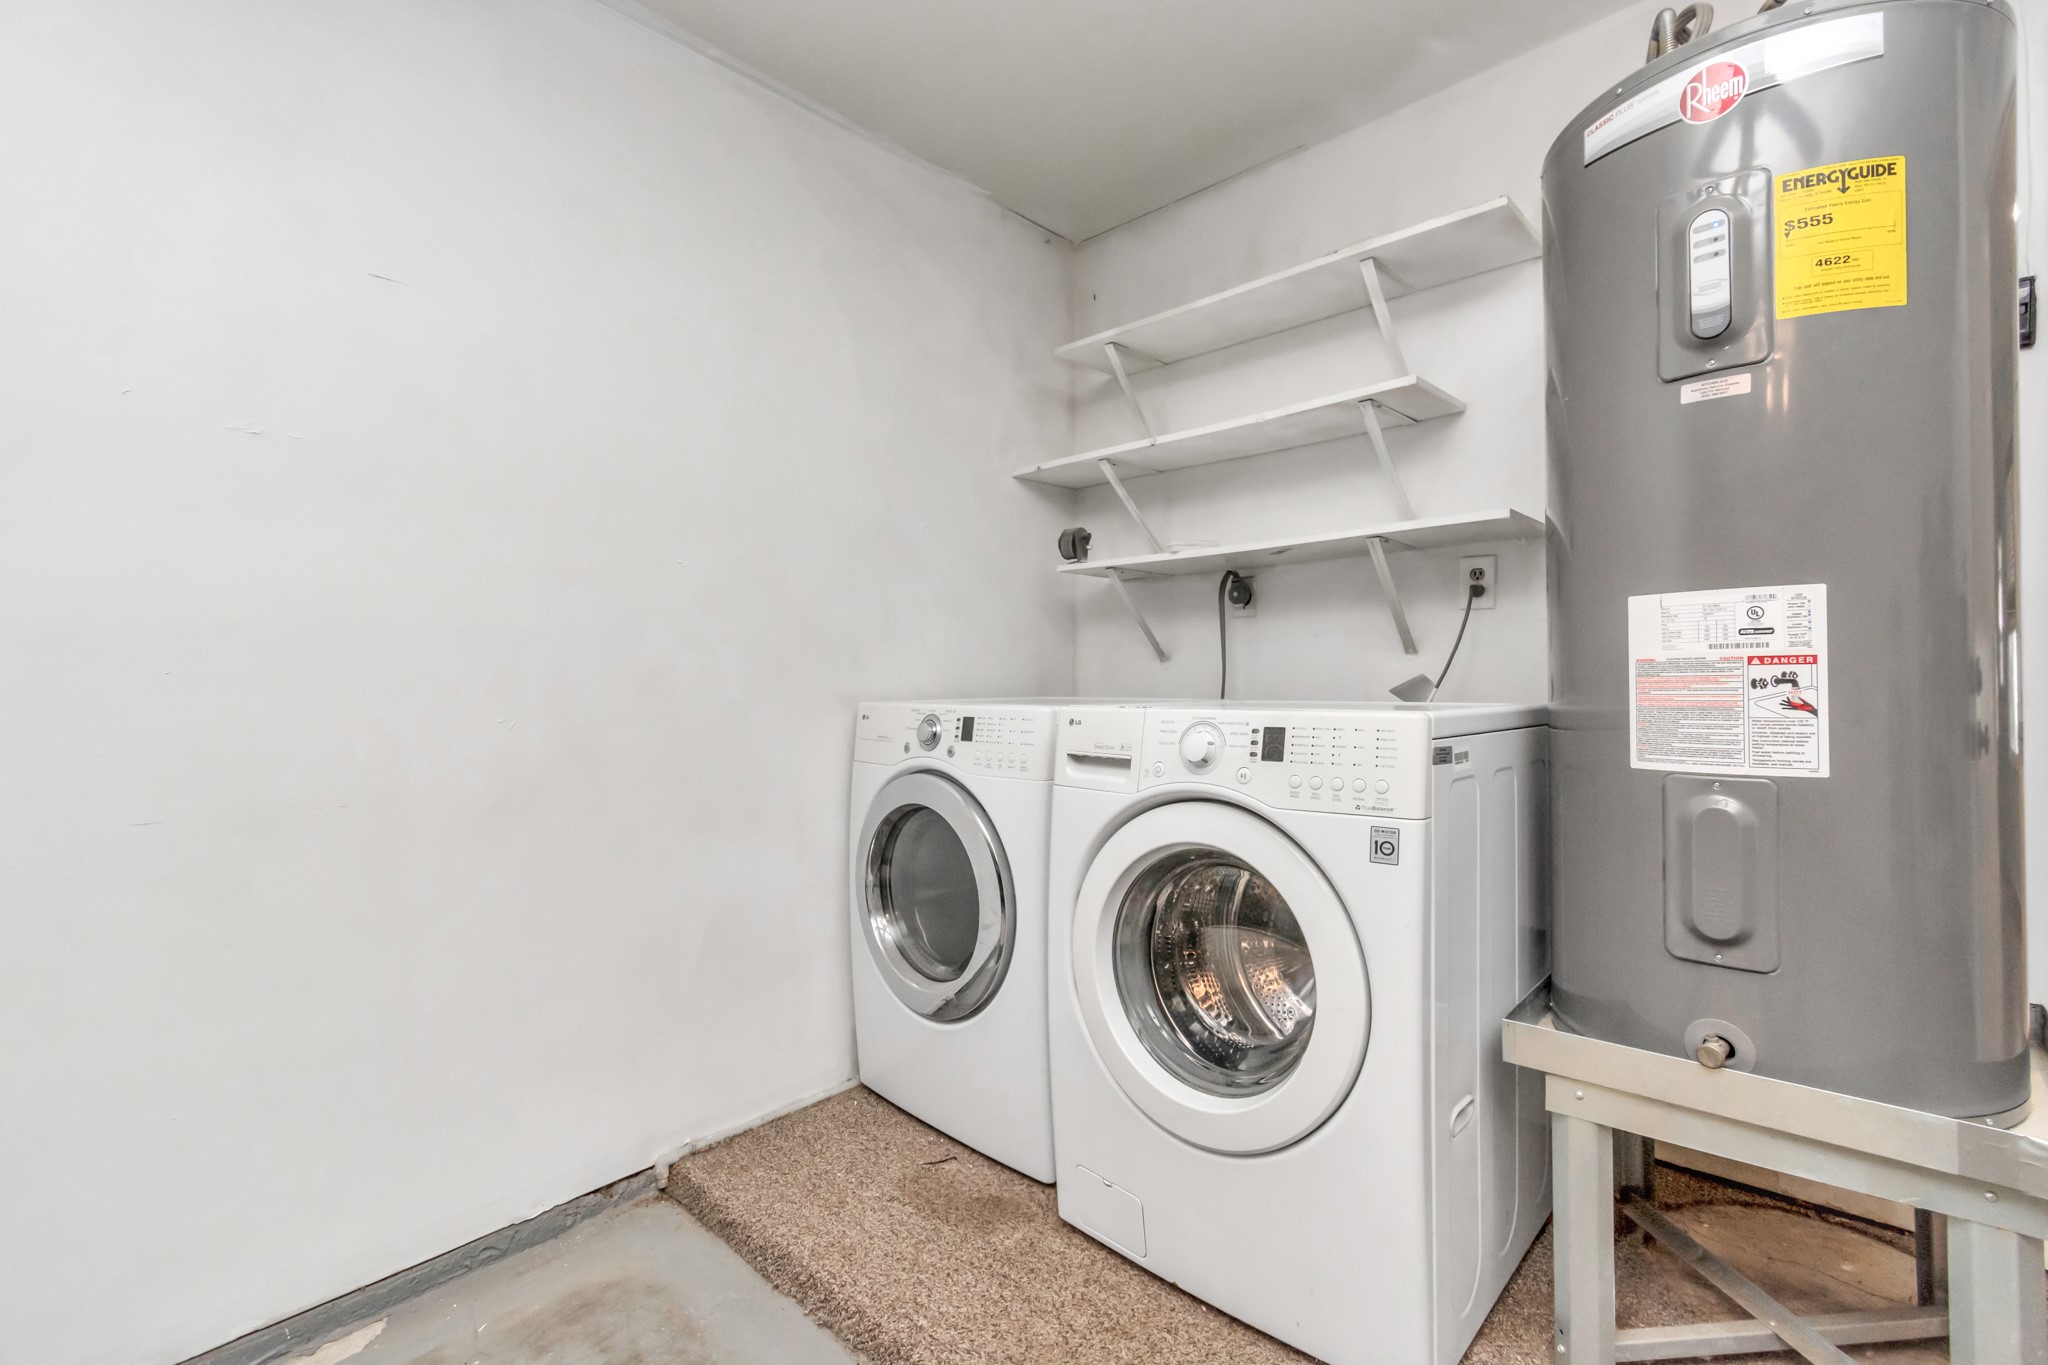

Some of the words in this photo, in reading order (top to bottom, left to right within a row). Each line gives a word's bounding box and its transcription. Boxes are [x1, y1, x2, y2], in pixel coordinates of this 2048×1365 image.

[1686, 68, 1744, 119] Rheem
[1586, 114, 1614, 138] CLASSIC
[1782, 162, 1897, 193] ENERGYGUIDE
[1784, 212, 1834, 232] $555
[1815, 255, 1851, 267] 4622
[1763, 656, 1813, 664] DANGER
[1374, 839, 1395, 857] 10
